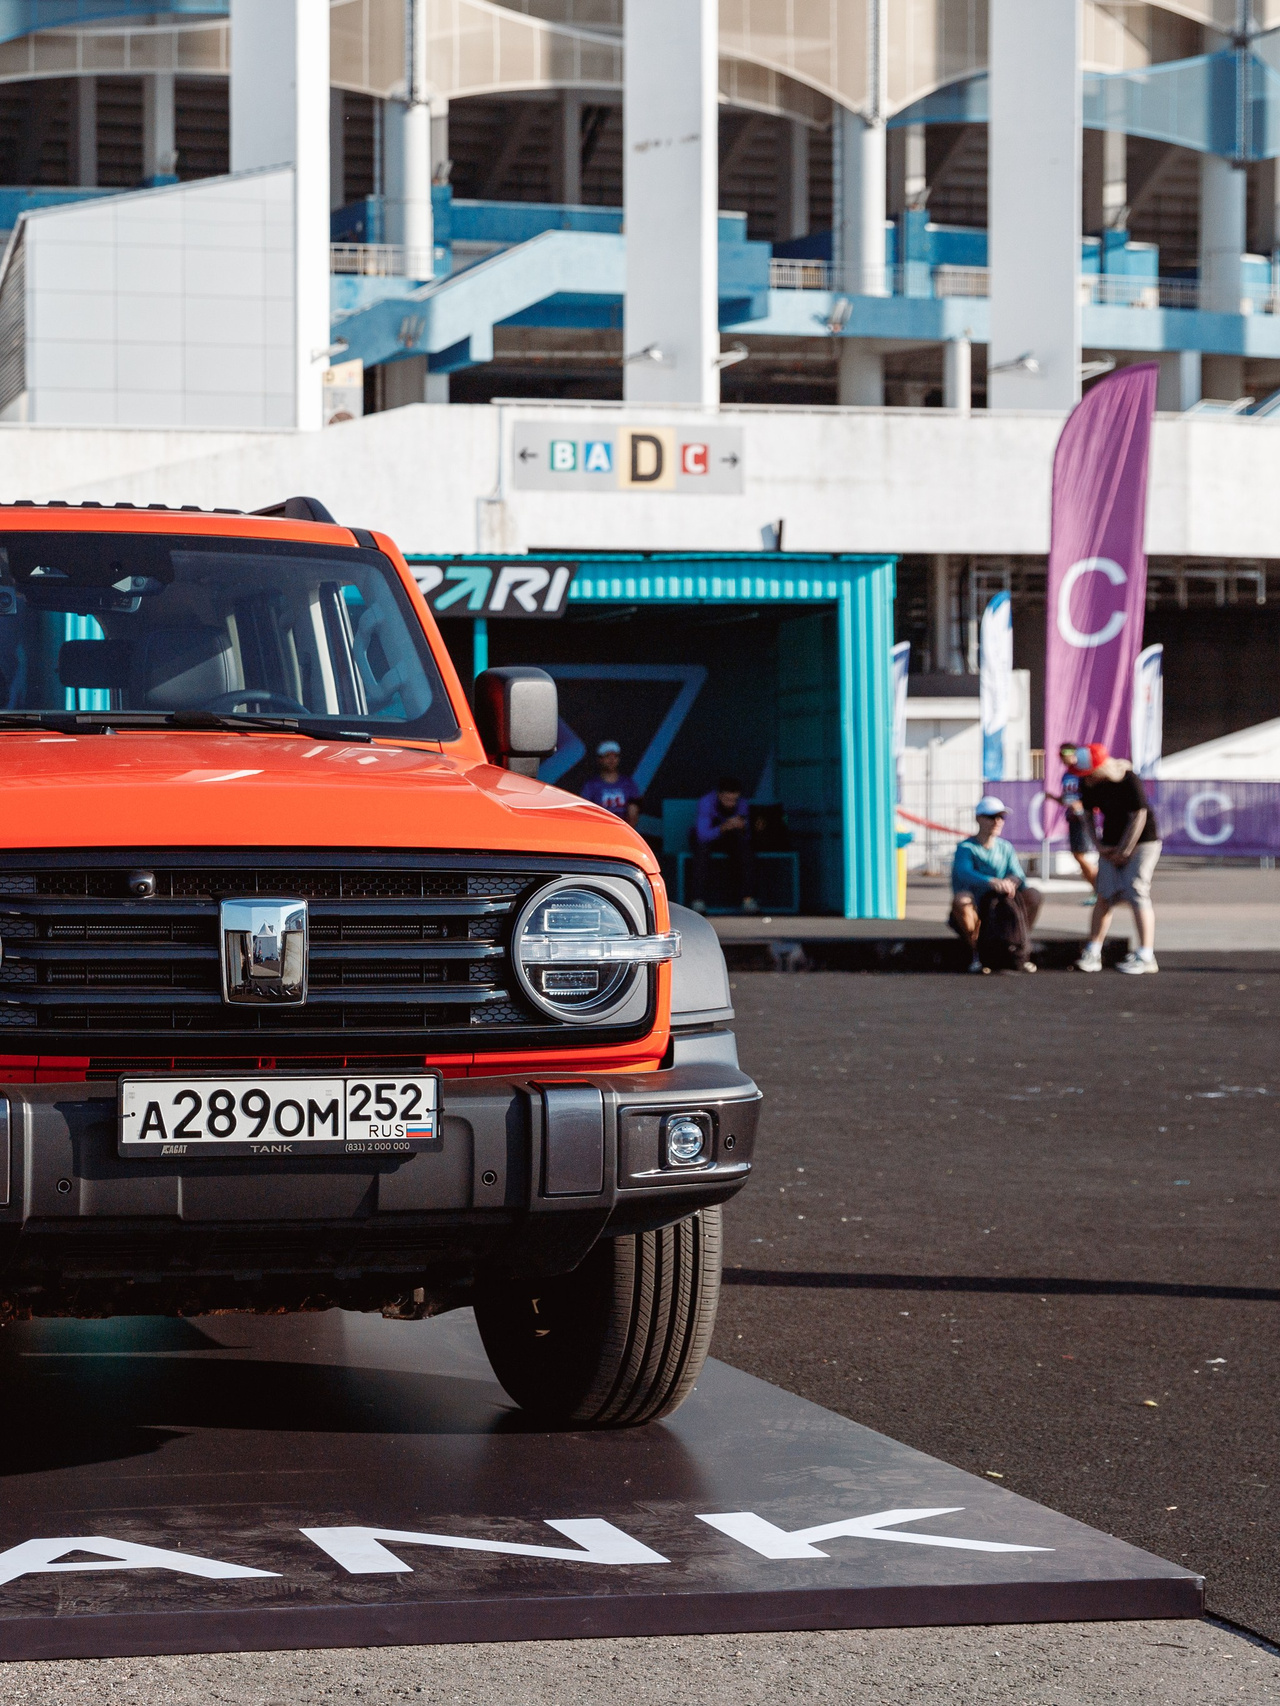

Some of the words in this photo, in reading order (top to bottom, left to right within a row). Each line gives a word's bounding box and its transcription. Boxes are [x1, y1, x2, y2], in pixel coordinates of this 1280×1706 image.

[554, 442, 575, 470] B
[587, 443, 609, 470] A
[630, 433, 664, 482] D
[685, 445, 706, 474] C
[1056, 556, 1128, 648] C
[1184, 791, 1235, 845] C
[349, 1083, 423, 1121] 252
[250, 1144, 293, 1153] TANK
[345, 1143, 365, 1152] (831)
[367, 1143, 373, 1151] 2
[374, 1142, 392, 1151] 000
[393, 1142, 410, 1150] 000
[368, 1124, 405, 1138] RUS
